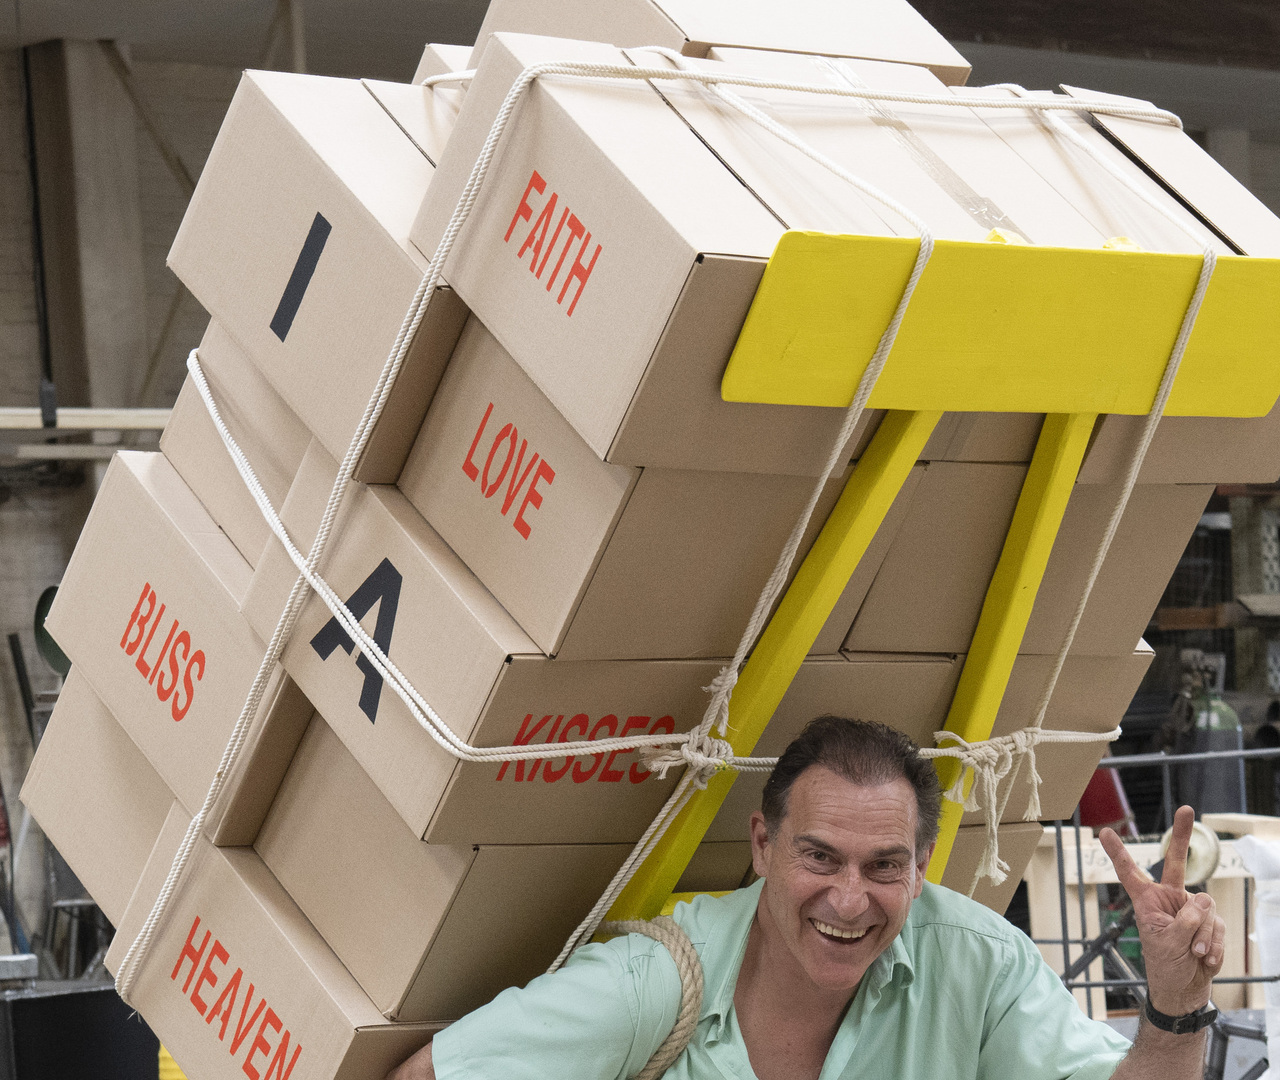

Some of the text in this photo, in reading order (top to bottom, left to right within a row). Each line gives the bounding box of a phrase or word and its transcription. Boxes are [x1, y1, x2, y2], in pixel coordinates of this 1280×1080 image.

[269, 211, 332, 343] I
[504, 170, 603, 317] FAITH
[462, 402, 556, 541] LOVE
[120, 582, 206, 722] BLISS
[310, 557, 403, 725] A
